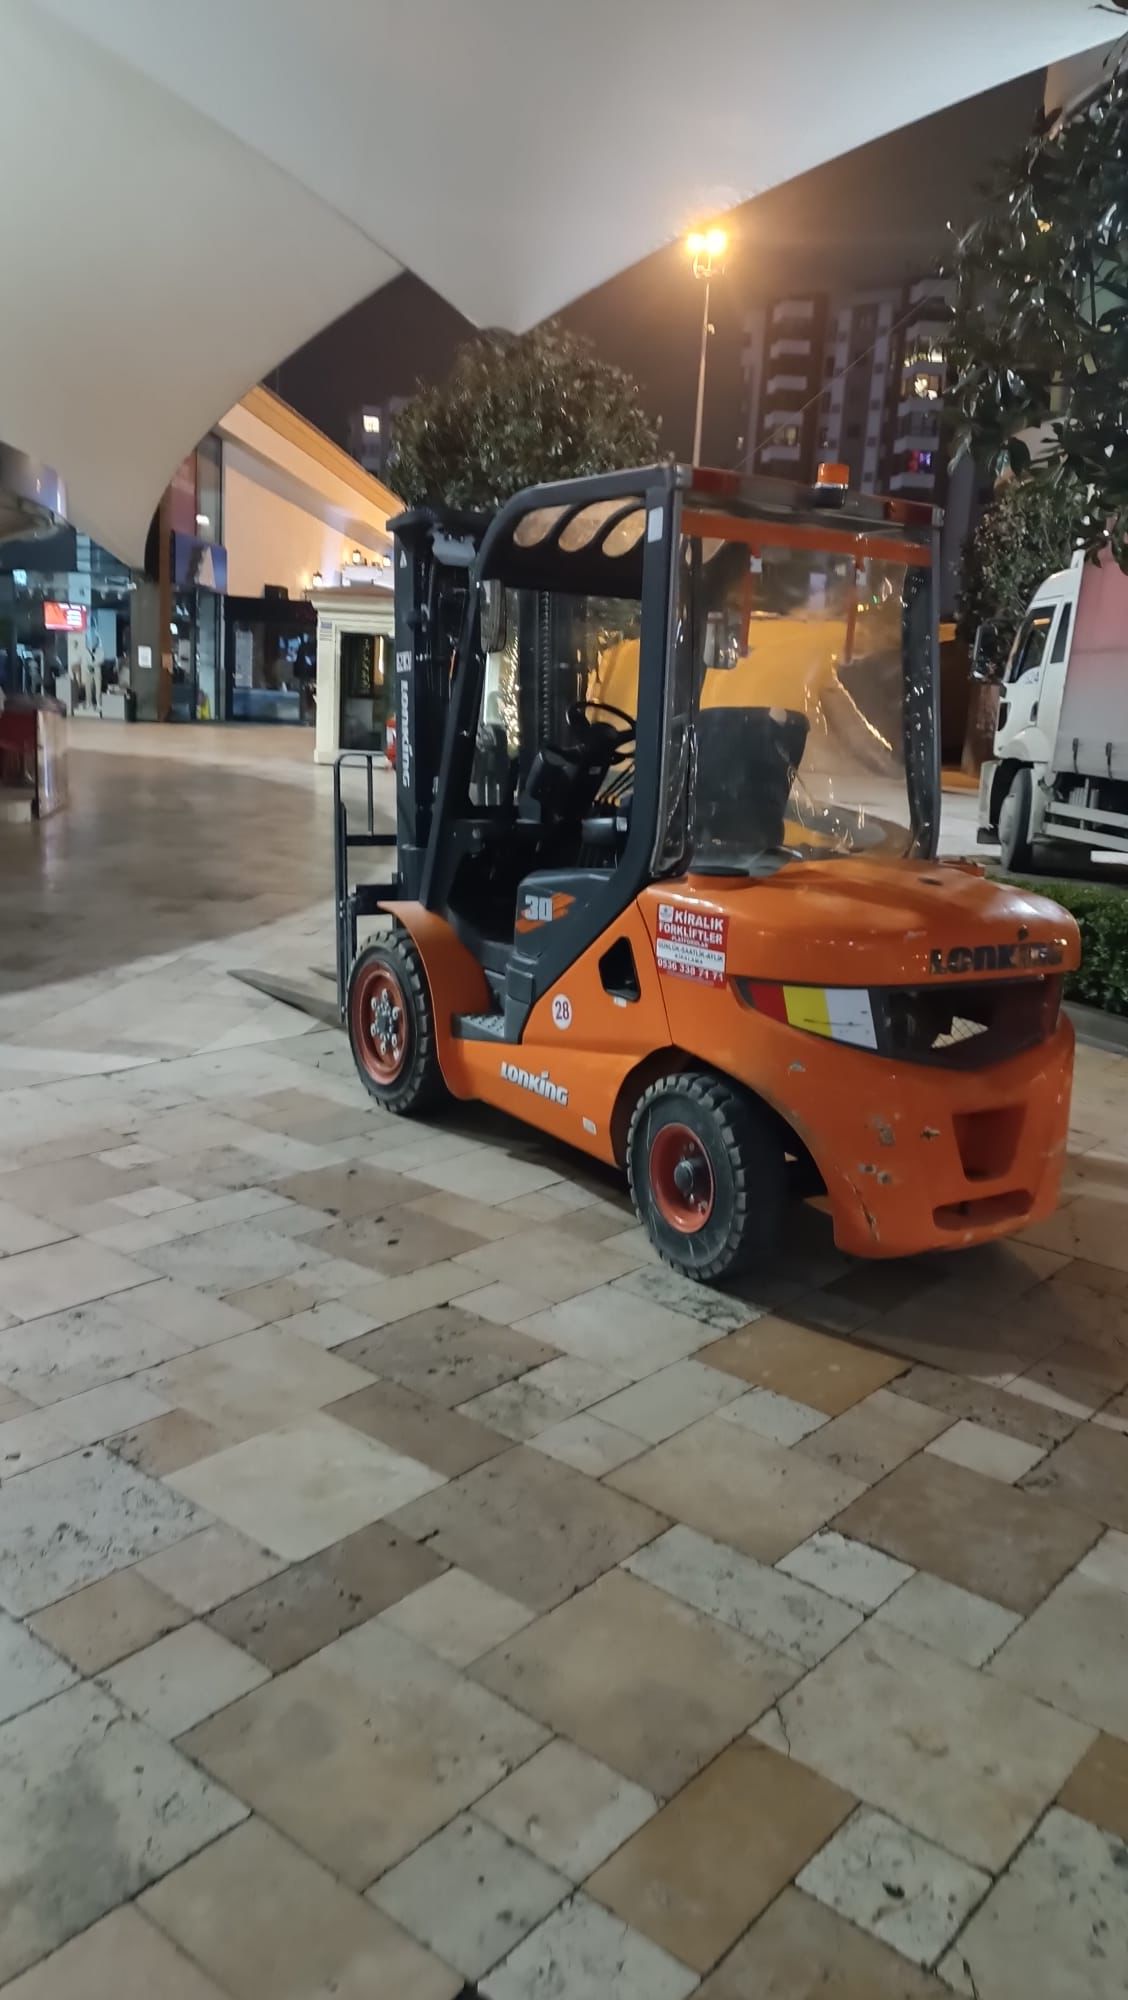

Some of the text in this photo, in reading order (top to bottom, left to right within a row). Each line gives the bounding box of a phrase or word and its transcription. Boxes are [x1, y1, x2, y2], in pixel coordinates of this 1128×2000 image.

[524, 894, 553, 922] 30
[675, 909, 724, 932] KİRALIK
[658, 922, 723, 945] FORKLİFTLER
[554, 1000, 570, 1020] 28
